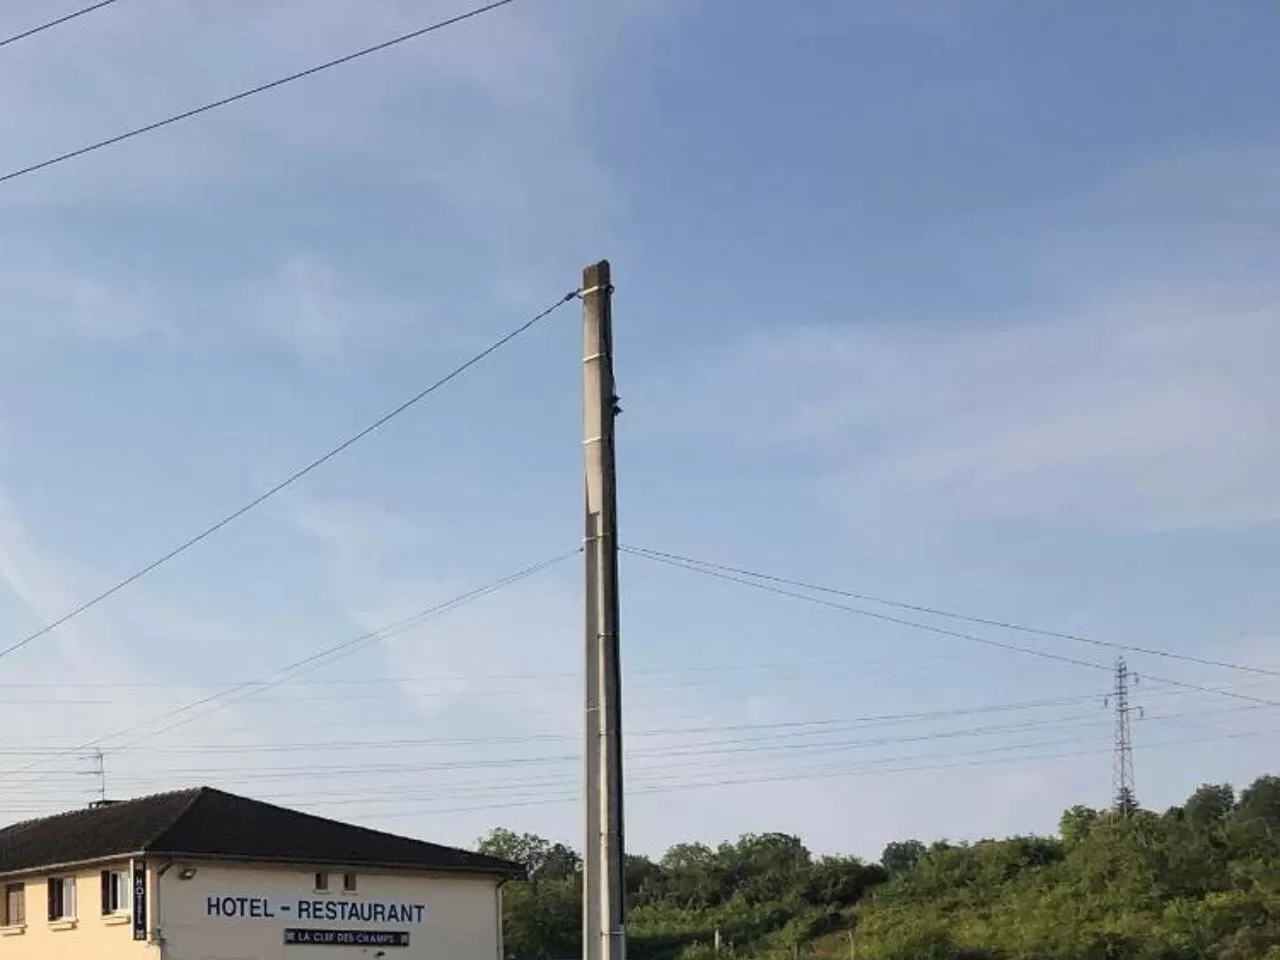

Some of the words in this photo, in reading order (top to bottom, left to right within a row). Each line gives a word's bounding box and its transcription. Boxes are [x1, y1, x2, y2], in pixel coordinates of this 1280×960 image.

[135, 876, 144, 925] HOTEL
[207, 897, 274, 918] HOTEL
[298, 900, 425, 923] RESTAURANT
[298, 932, 311, 941] LA
[314, 932, 335, 942] CLEF
[337, 933, 355, 943] DES
[356, 934, 395, 944] CHAMPS
